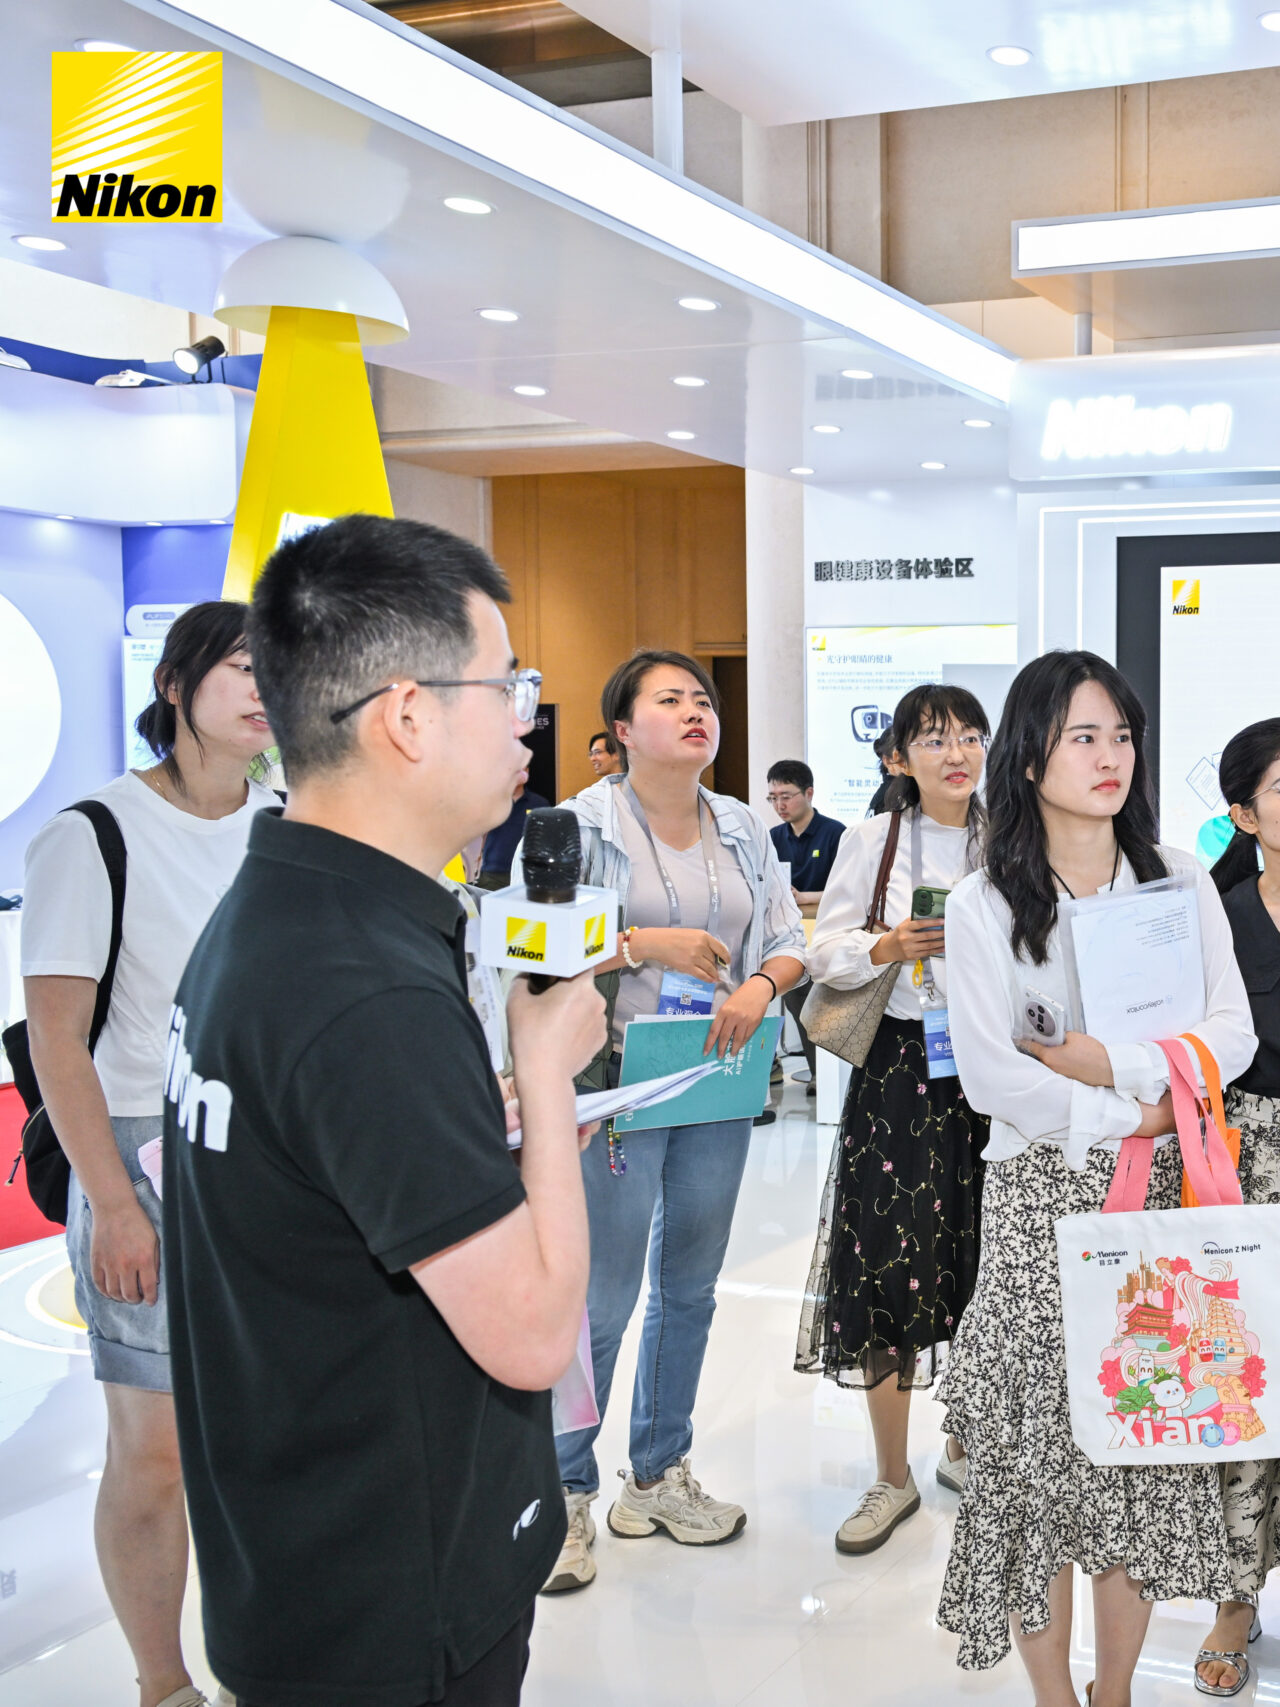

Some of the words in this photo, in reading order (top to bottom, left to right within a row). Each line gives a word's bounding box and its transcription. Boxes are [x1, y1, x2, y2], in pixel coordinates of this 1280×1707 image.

[1041, 395, 1232, 460] Nikon
[814, 557, 974, 582] 眼健康设备体验区
[1172, 605, 1199, 614] Nikon
[507, 945, 544, 961] Nikon
[584, 942, 604, 958] Nikon
[163, 1002, 233, 1153] ikon
[1204, 1247, 1234, 1255] Menicon
[1241, 1244, 1261, 1253] Night
